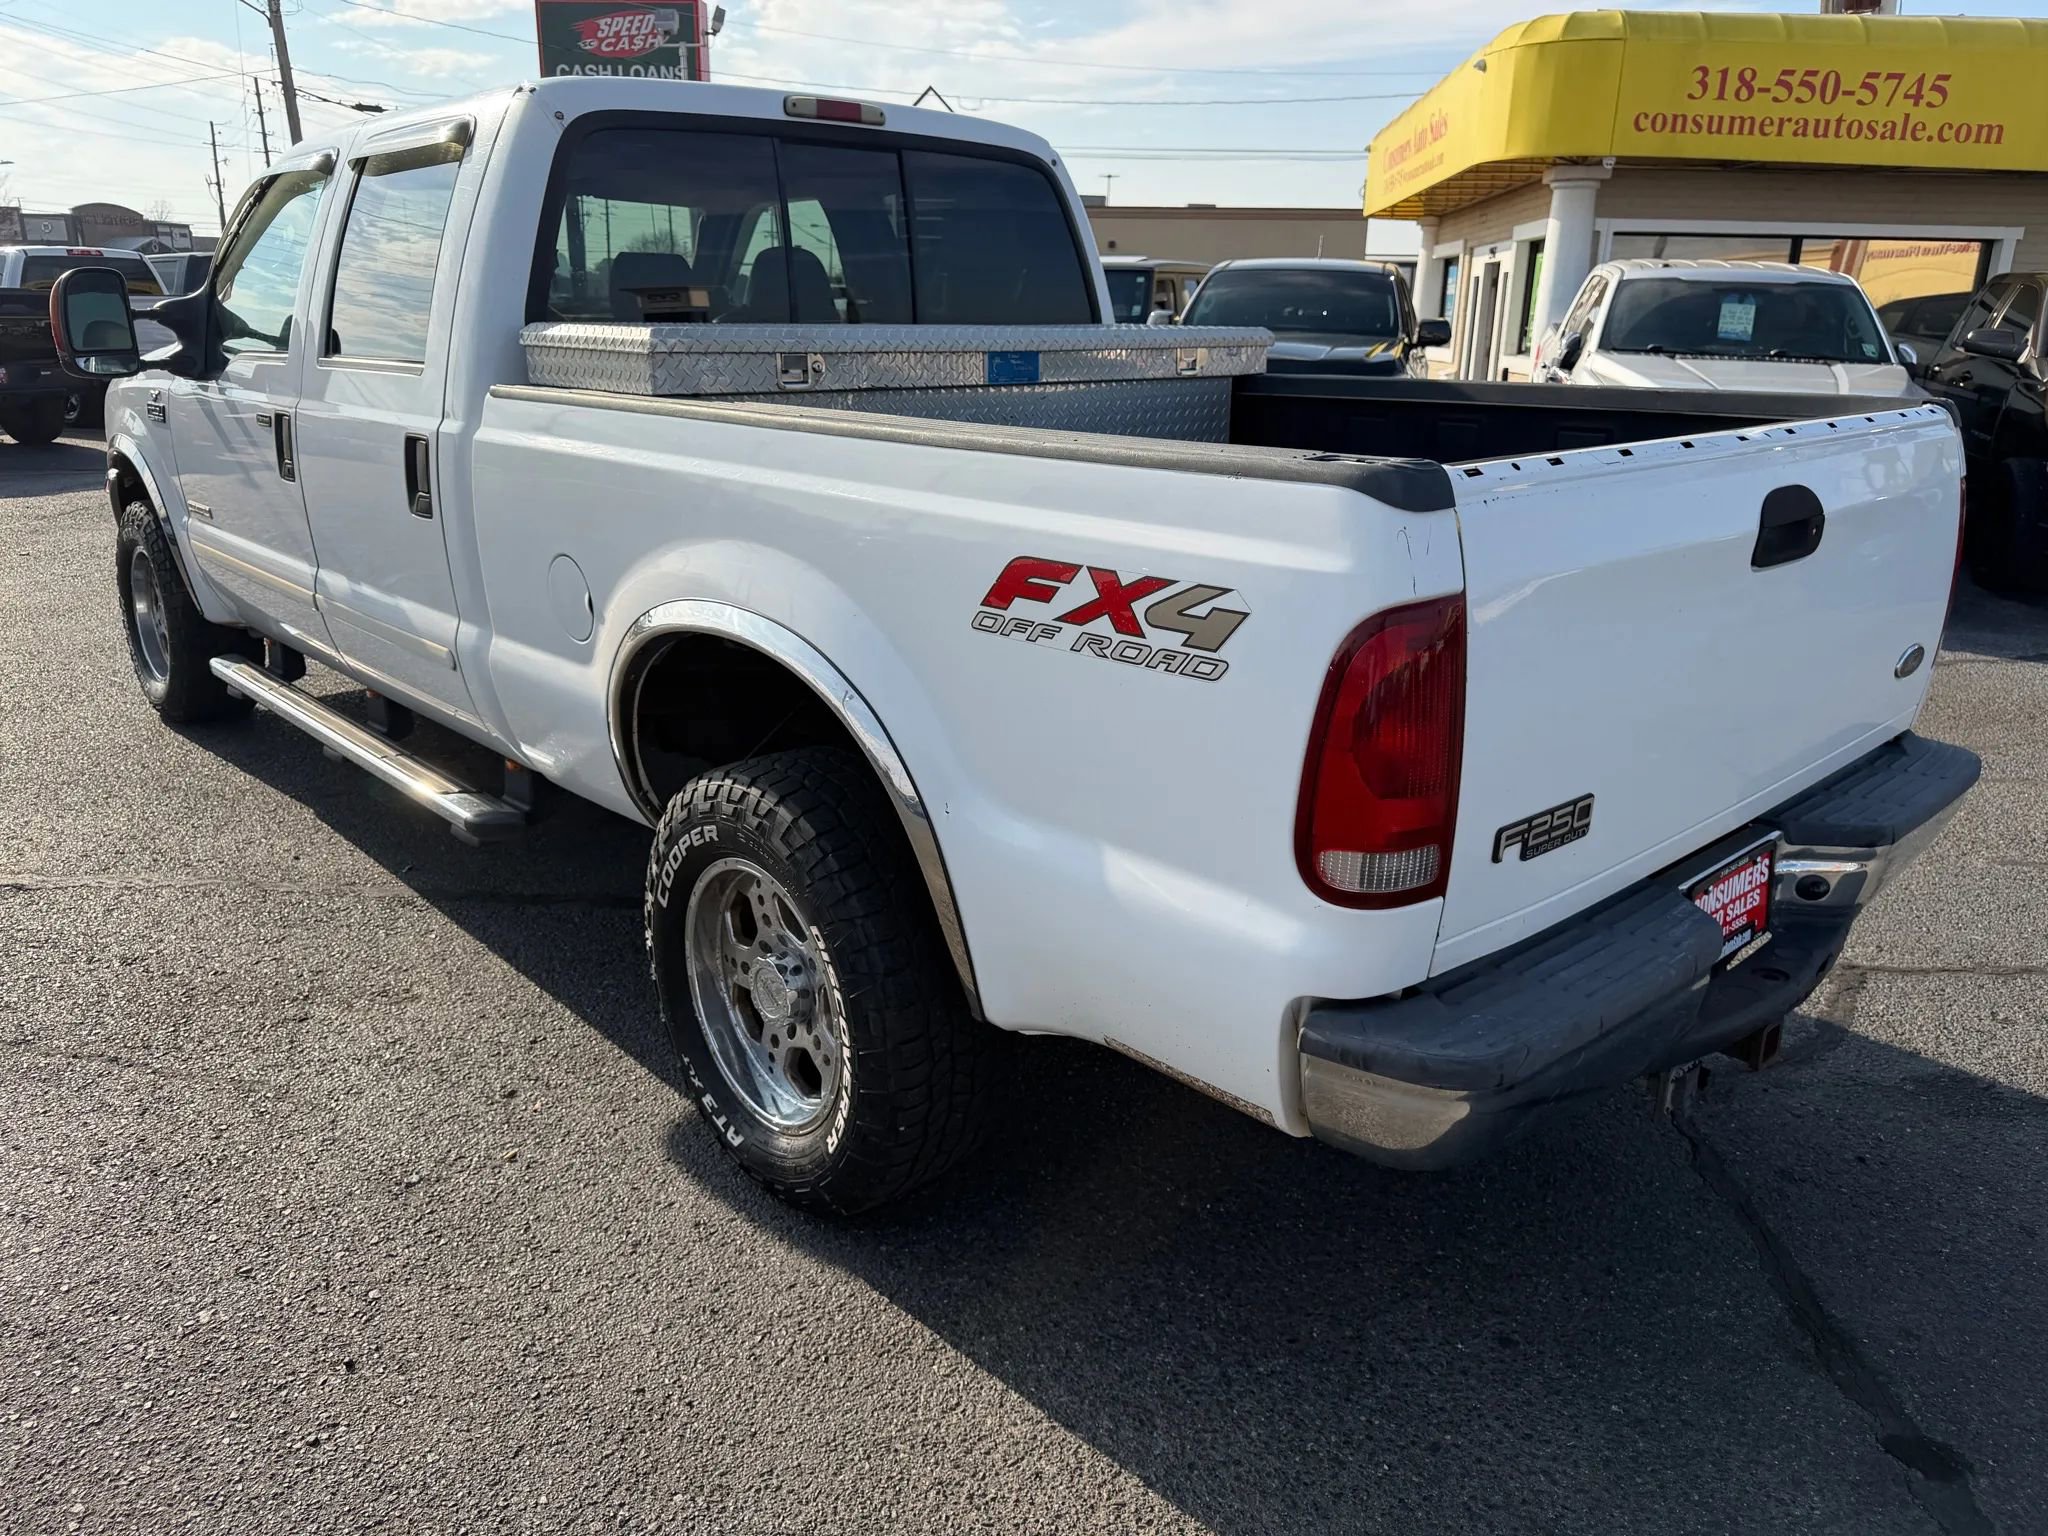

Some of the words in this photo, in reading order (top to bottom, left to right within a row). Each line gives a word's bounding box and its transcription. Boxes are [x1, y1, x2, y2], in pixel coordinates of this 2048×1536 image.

[597, 14, 660, 38] SPEED
[556, 63, 612, 77] CASH
[1687, 65, 1953, 109] 318-550-5745
[1632, 111, 2005, 145] consumerautosale.com
[980, 555, 1251, 653] FX4
[971, 611, 1063, 642] OFF
[1070, 631, 1230, 682] ROAD
[1525, 838, 1561, 860] SUPER
[1562, 826, 1590, 844] DUTY
[657, 824, 719, 909] COOPER
[1726, 888, 1761, 922] SALES
[809, 925, 852, 1154] DISCOVERER
[701, 1093, 745, 1147] AT3
